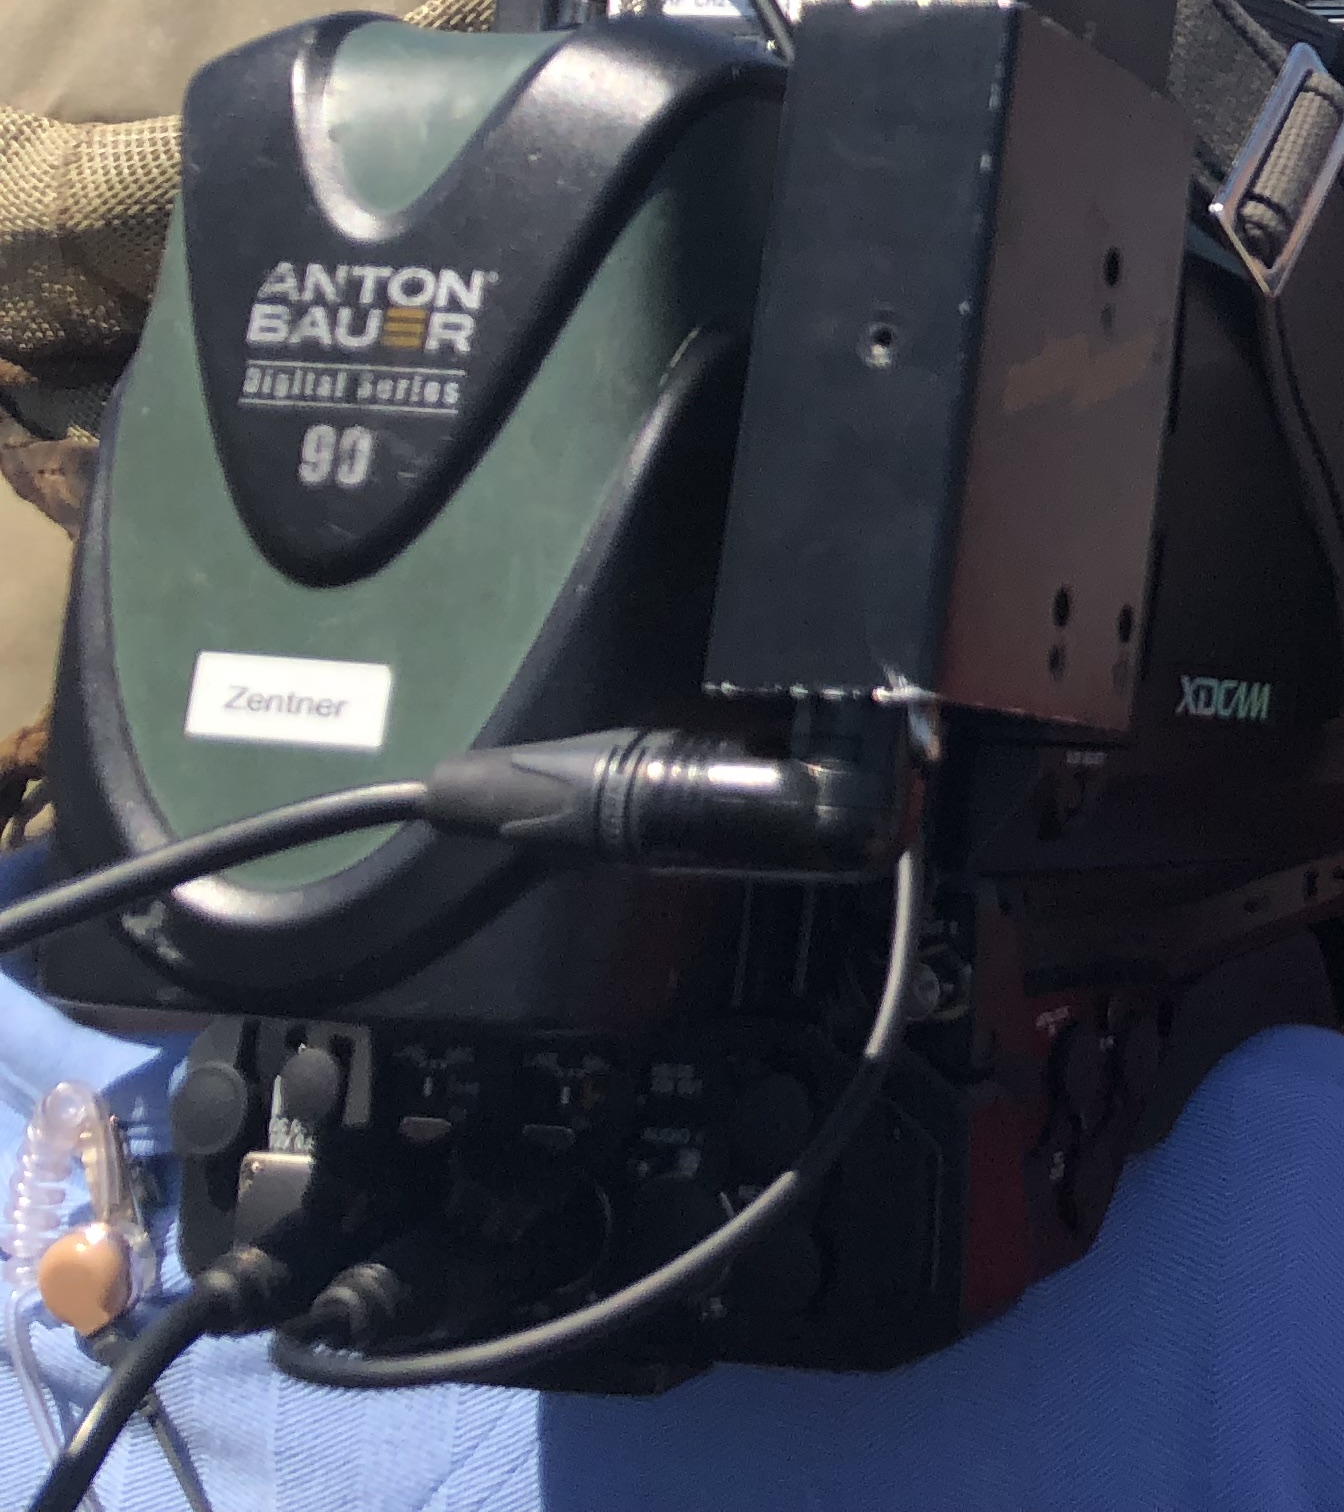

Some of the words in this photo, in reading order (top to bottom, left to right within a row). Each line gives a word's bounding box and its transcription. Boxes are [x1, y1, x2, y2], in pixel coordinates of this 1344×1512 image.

[256, 261, 486, 310] ANTON
[246, 303, 476, 352] BAUER
[299, 424, 373, 486] 90
[222, 684, 350, 718] Zentner
[1174, 674, 1271, 720] XDCAM
